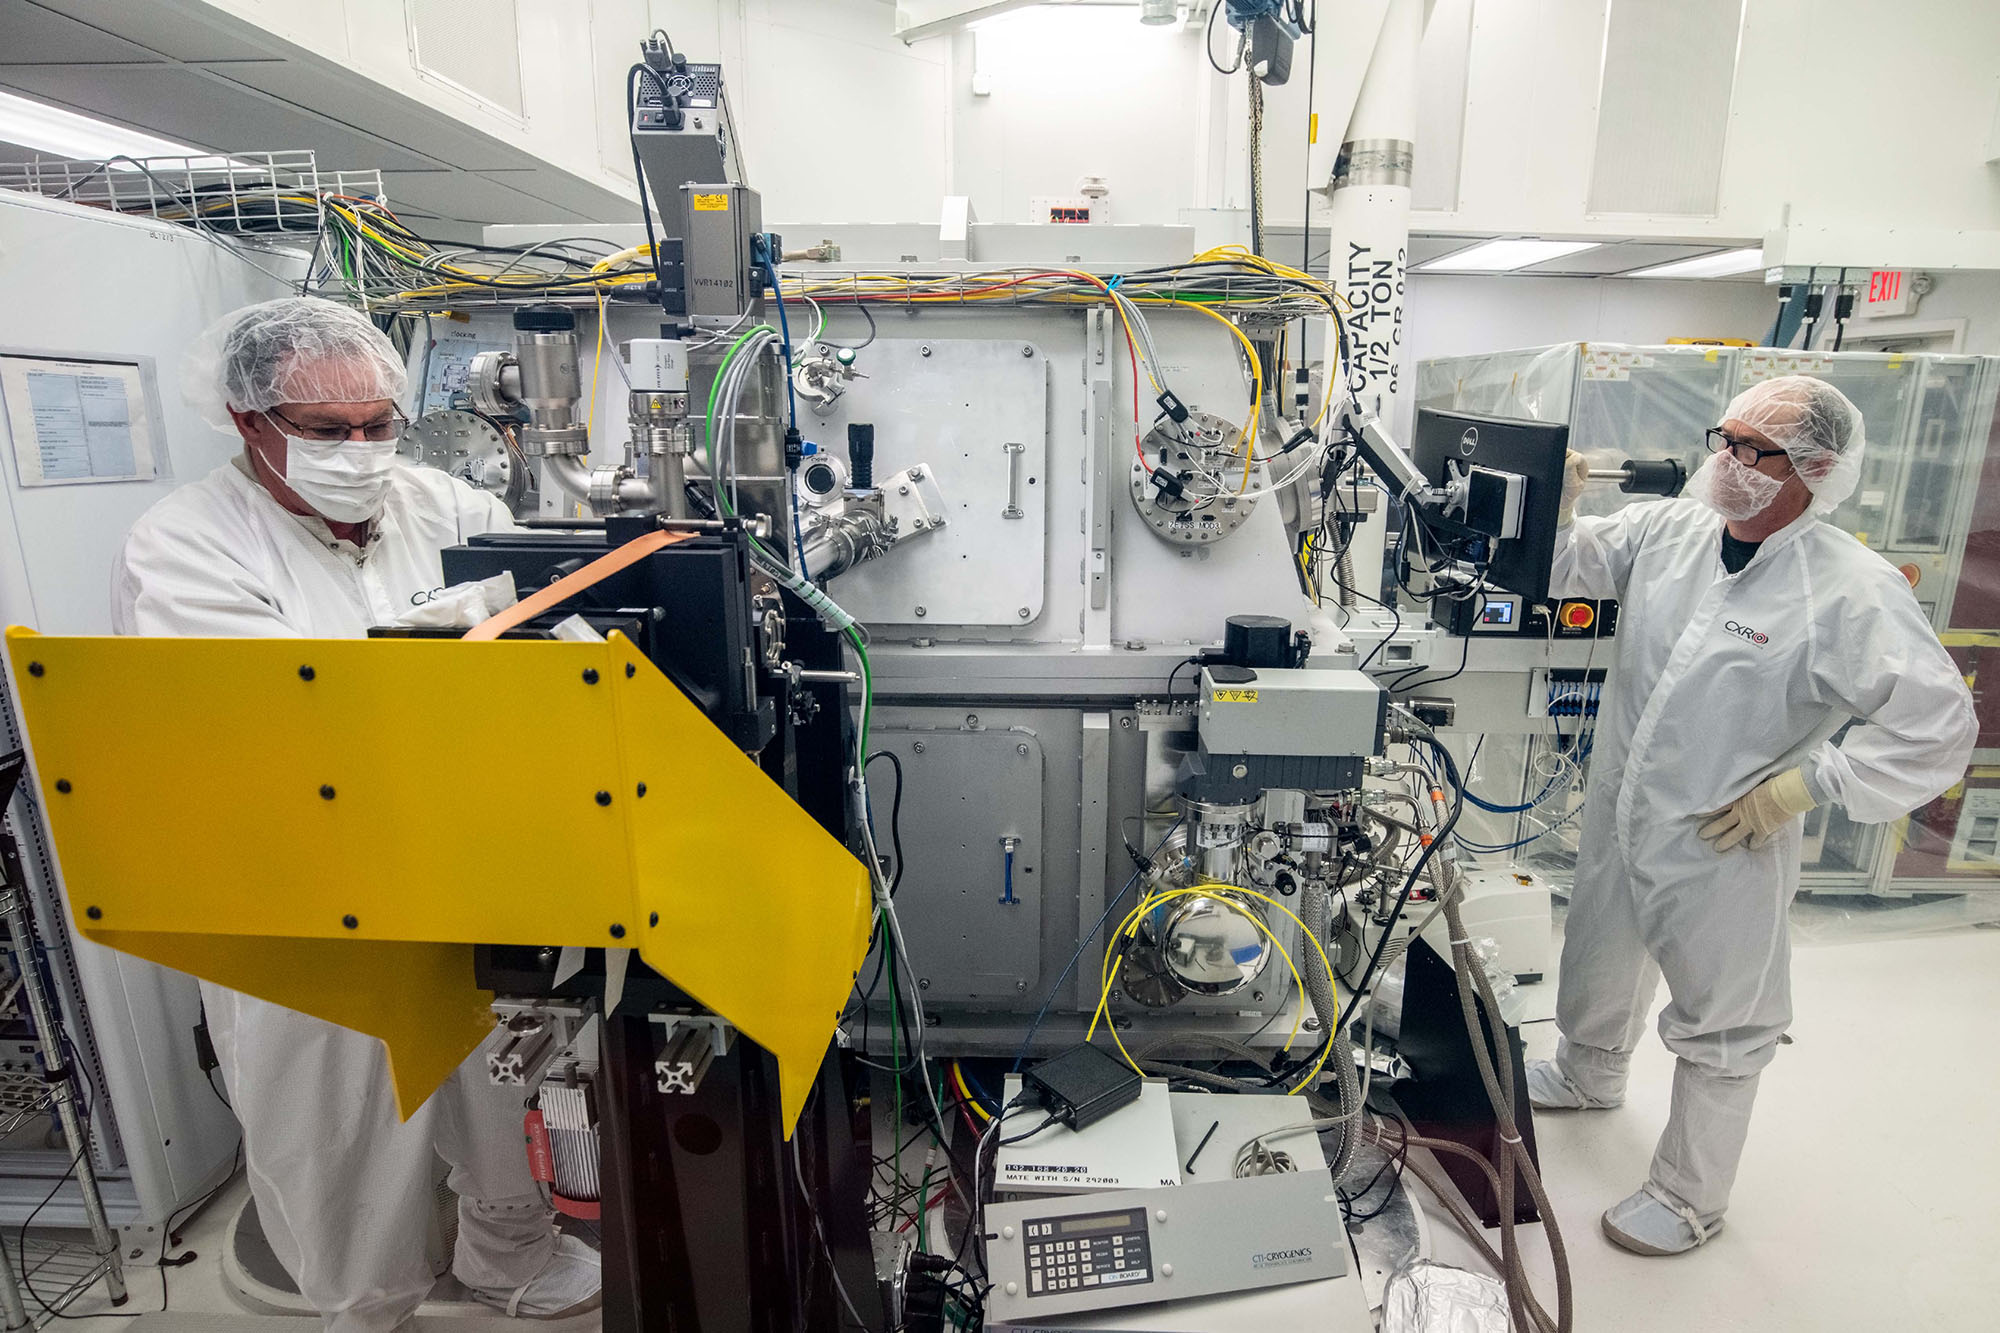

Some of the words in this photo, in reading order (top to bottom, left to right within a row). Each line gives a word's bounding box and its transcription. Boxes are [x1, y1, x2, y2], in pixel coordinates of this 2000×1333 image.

[694, 279, 734, 288] VVR14102
[1371, 261, 1392, 322] TON
[1347, 242, 1371, 392] CAPACITY
[1369, 342, 1389, 380] 1/2
[1462, 436, 1476, 446] DELL
[1006, 1164, 1087, 1174] 192.168.20.20
[1252, 1247, 1312, 1264] CTI-CRYOGENICS
